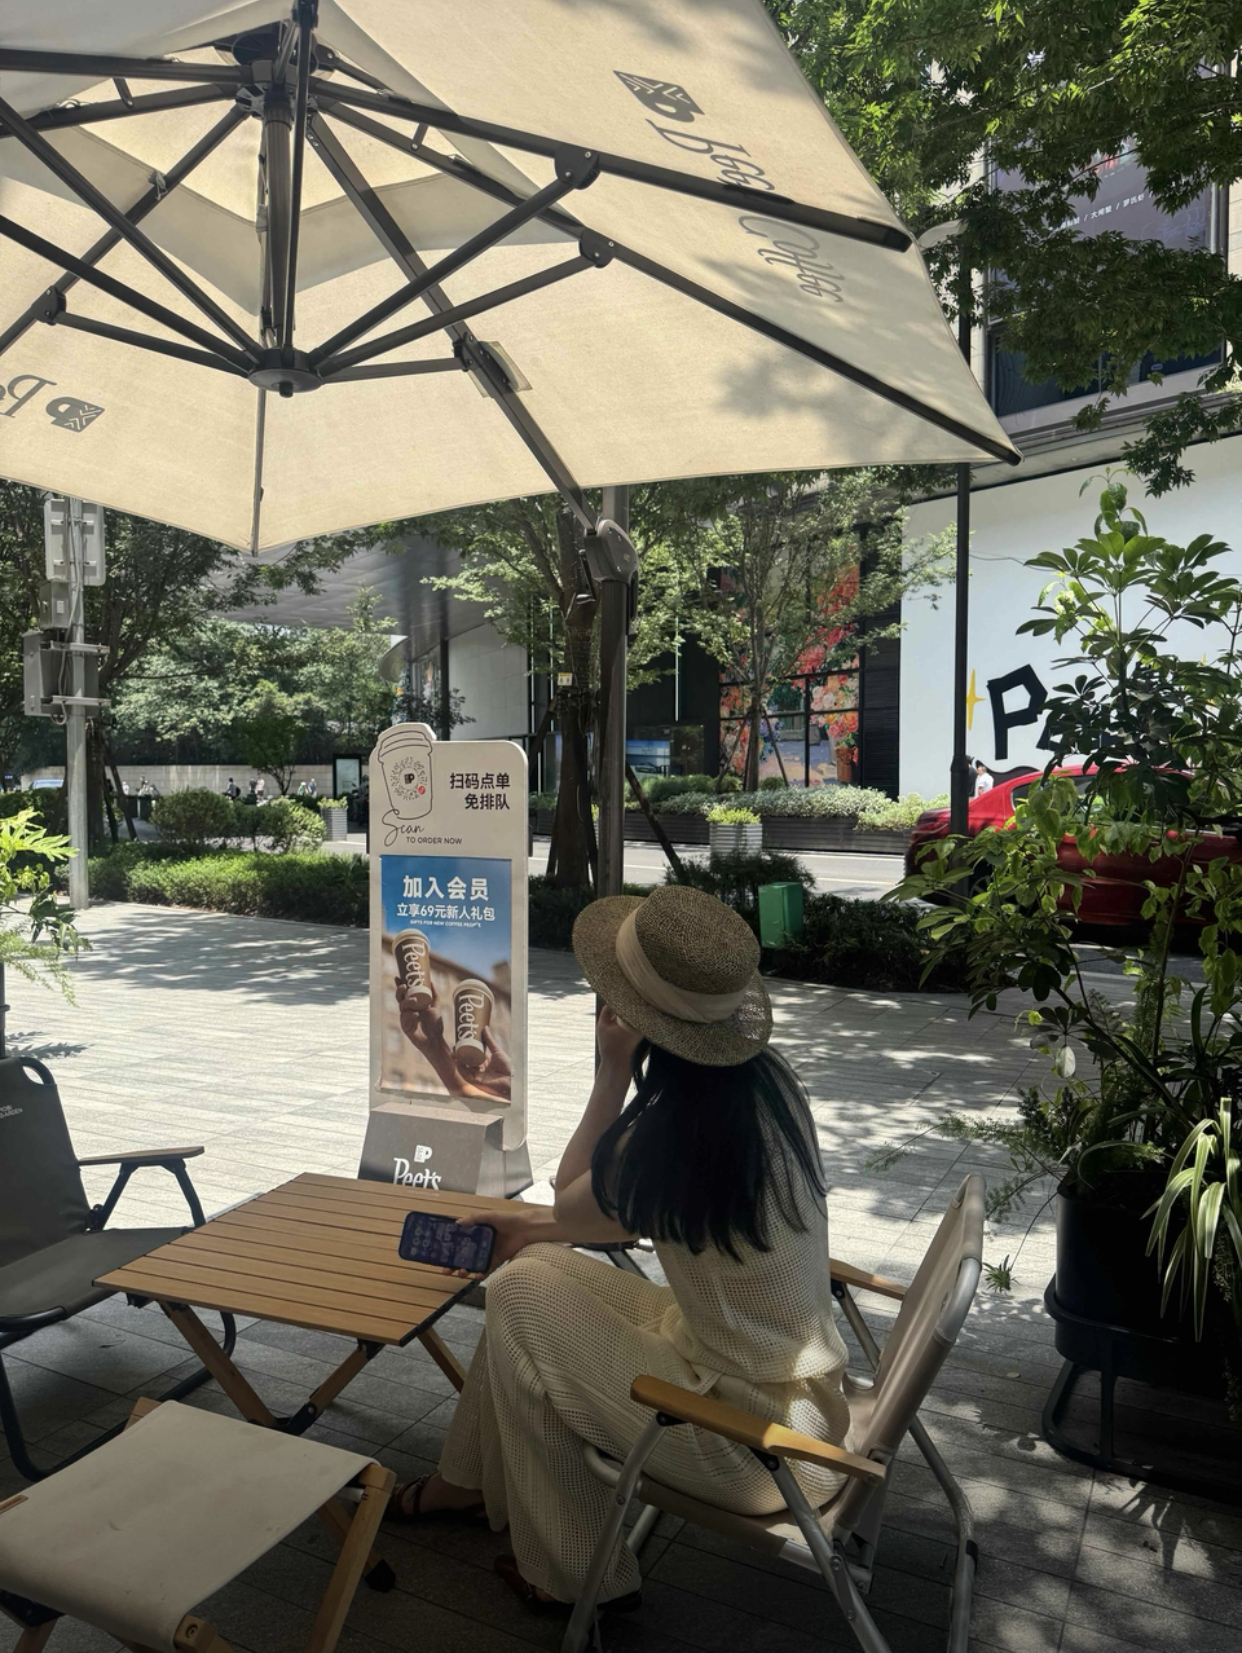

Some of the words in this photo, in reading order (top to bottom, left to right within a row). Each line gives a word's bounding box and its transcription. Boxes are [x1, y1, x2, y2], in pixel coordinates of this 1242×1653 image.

[449, 772, 511, 790] 扫码点单
[464, 793, 511, 811] 免排队
[381, 808, 425, 847] Scan
[406, 836, 416, 844] TO
[417, 836, 442, 845] ORDER
[402, 874, 489, 901] 加入会员
[396, 902, 496, 921] 立享69元新人礼包
